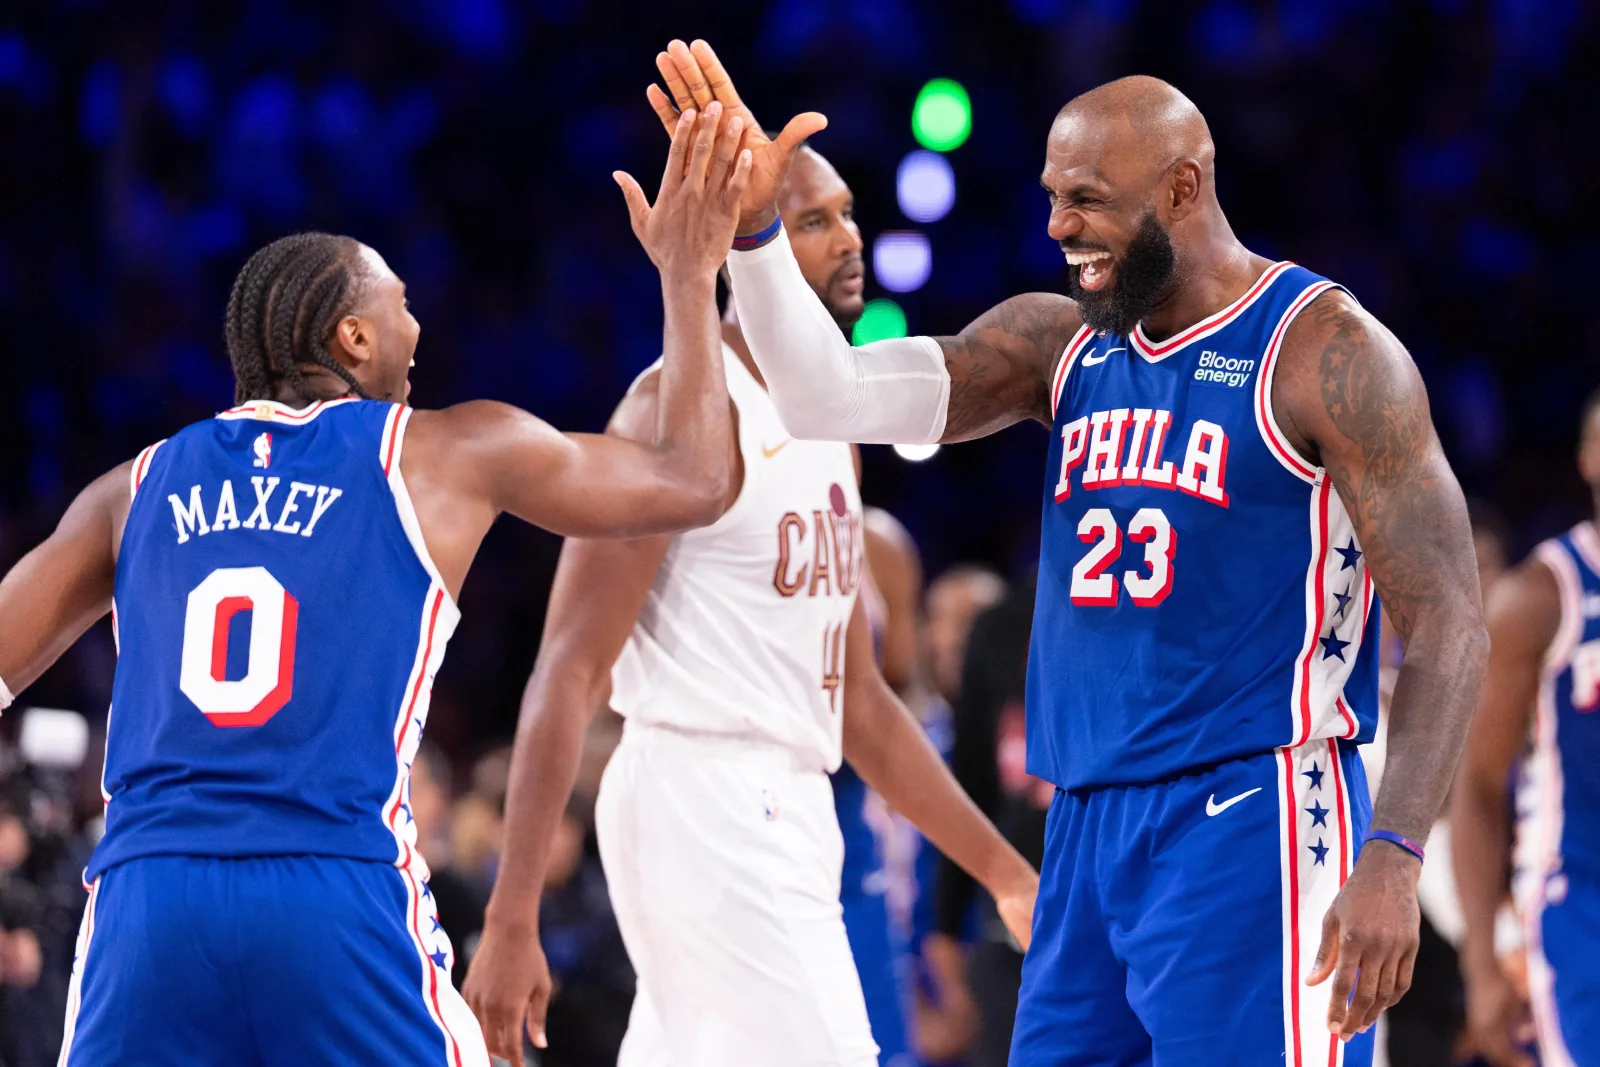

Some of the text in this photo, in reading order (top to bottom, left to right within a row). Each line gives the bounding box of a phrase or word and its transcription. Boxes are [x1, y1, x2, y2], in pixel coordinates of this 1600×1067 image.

[1194, 368, 1250, 388] energy
[1199, 350, 1255, 372] Bloom
[1054, 408, 1230, 508] PHILA
[168, 476, 343, 545] MAXEY
[773, 511, 861, 597] CAV
[1070, 508, 1178, 608] 23
[179, 565, 300, 729] 0
